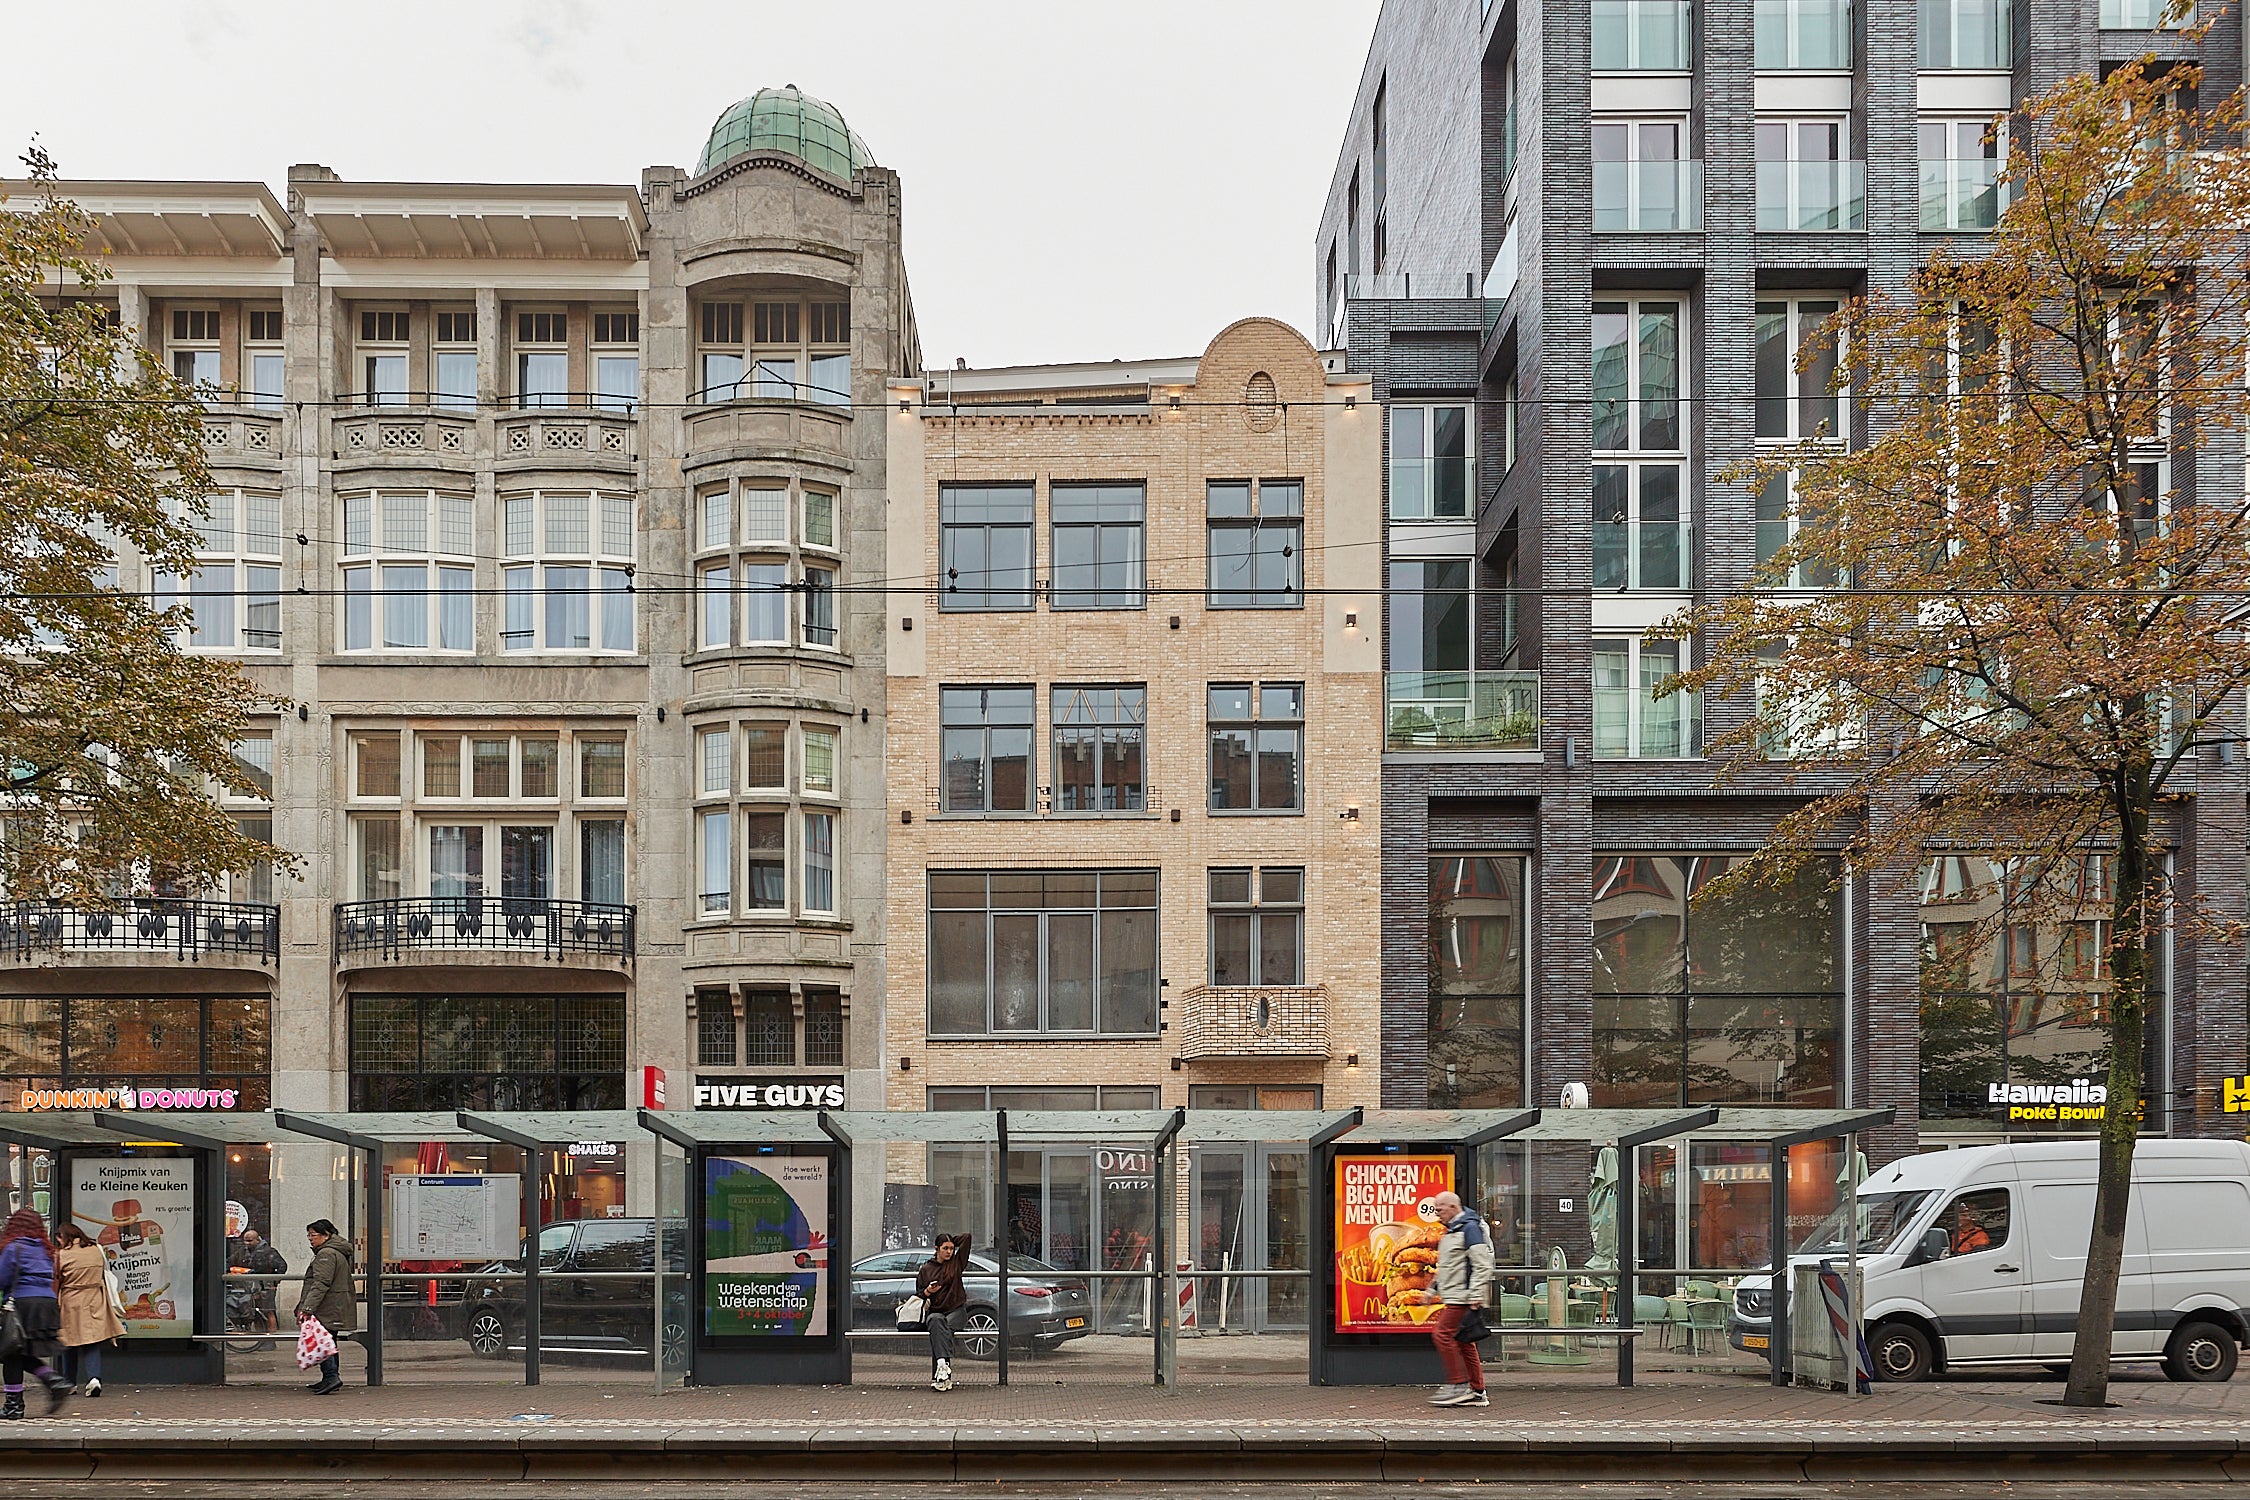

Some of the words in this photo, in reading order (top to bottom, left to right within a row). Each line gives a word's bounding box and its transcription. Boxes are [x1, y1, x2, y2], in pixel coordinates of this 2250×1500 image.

[693, 1085, 758, 1107] FIVE
[764, 1084, 845, 1107] GUYS
[1988, 1078, 2108, 1103] Hawaiia
[21, 1090, 119, 1109] DUNKIN'
[139, 1088, 237, 1109] DONUTS
[568, 1144, 617, 1156] SHAKES
[99, 1167, 147, 1178] Knijpmix
[150, 1168, 170, 1176] van
[1345, 1164, 1419, 1185] CHICKEN
[80, 1181, 96, 1191] de
[100, 1181, 139, 1191] Kleine
[142, 1181, 188, 1191] Keuken
[1346, 1184, 1374, 1205] BIG
[1377, 1184, 1417, 1205] MAC
[1560, 1201, 1572, 1210] 40
[1345, 1204, 1395, 1225] MENU
[109, 1256, 161, 1271] Knijpmix
[126, 1271, 150, 1279] Mango
[125, 1277, 149, 1286] Wortel
[131, 1282, 152, 1291] Haver
[764, 1308, 806, 1320] oktober
